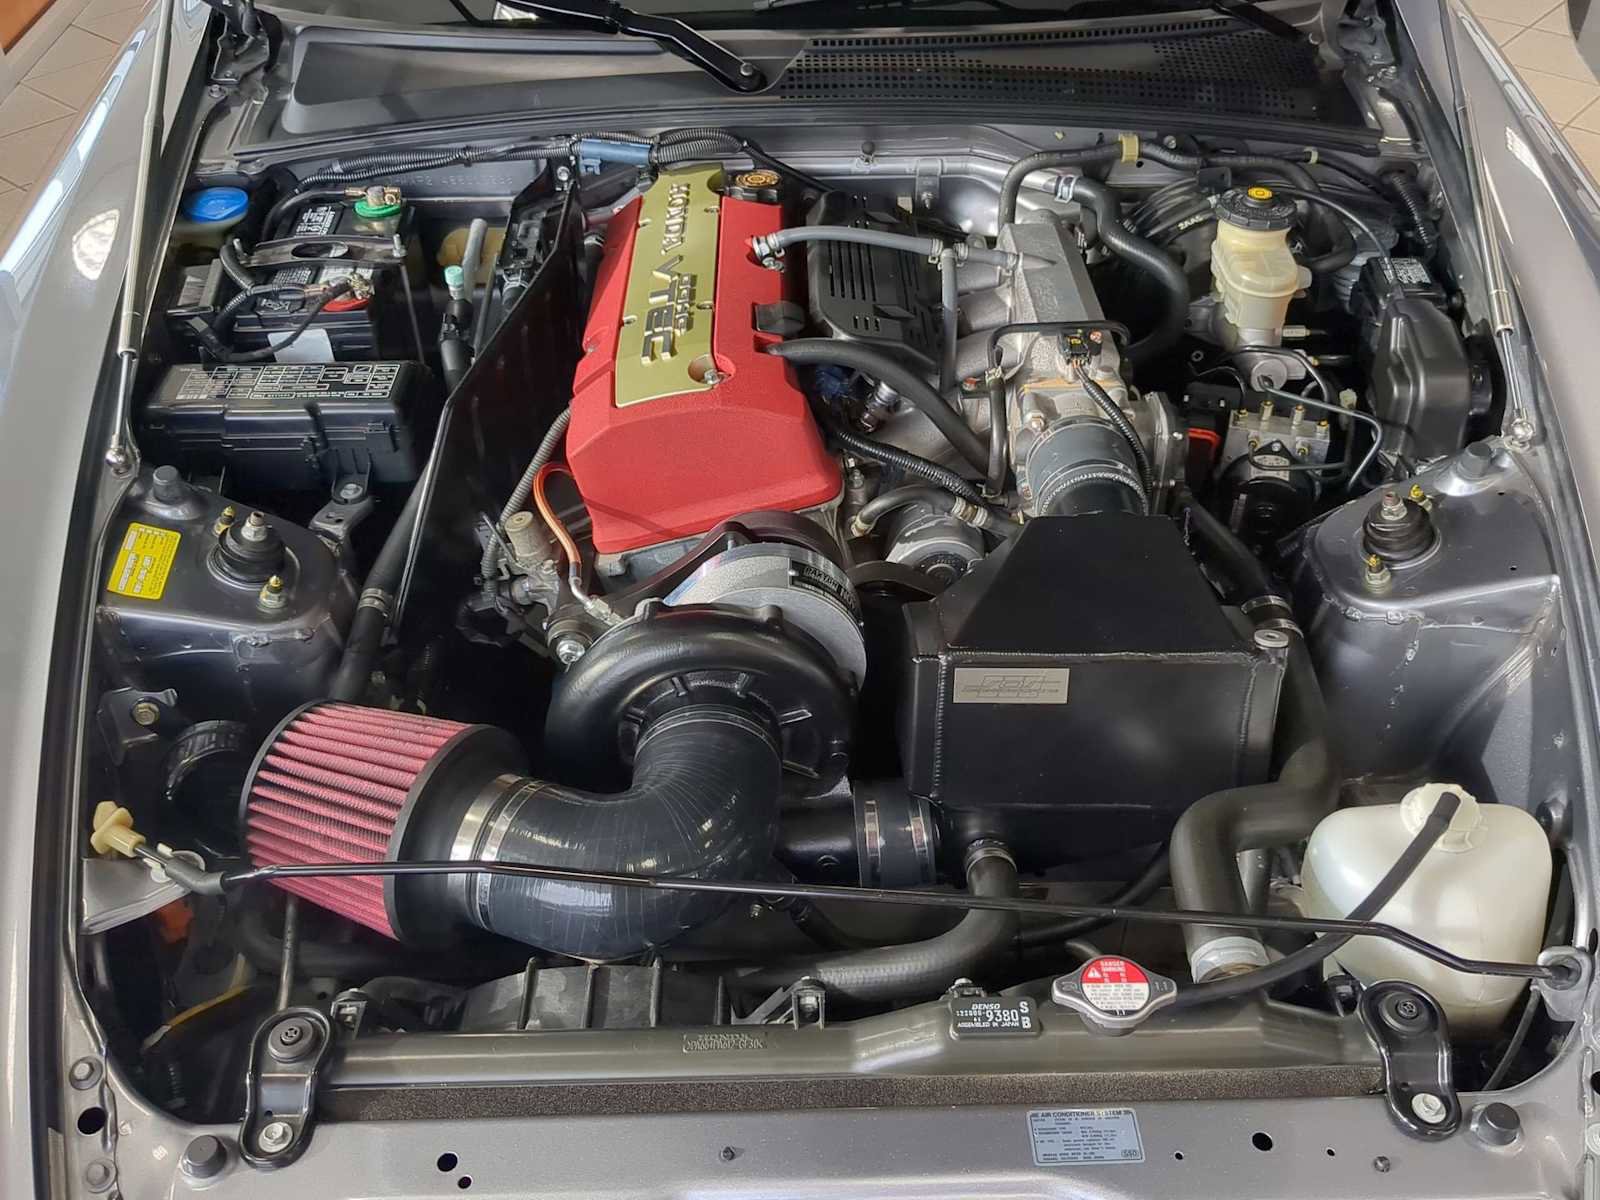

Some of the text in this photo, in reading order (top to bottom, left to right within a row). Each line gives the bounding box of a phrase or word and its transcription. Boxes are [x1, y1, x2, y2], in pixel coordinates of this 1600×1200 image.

[661, 183, 690, 255] HONDA
[641, 254, 684, 366] VTEC
[1019, 1001, 1029, 1013] S
[1021, 1016, 1032, 1029] B
